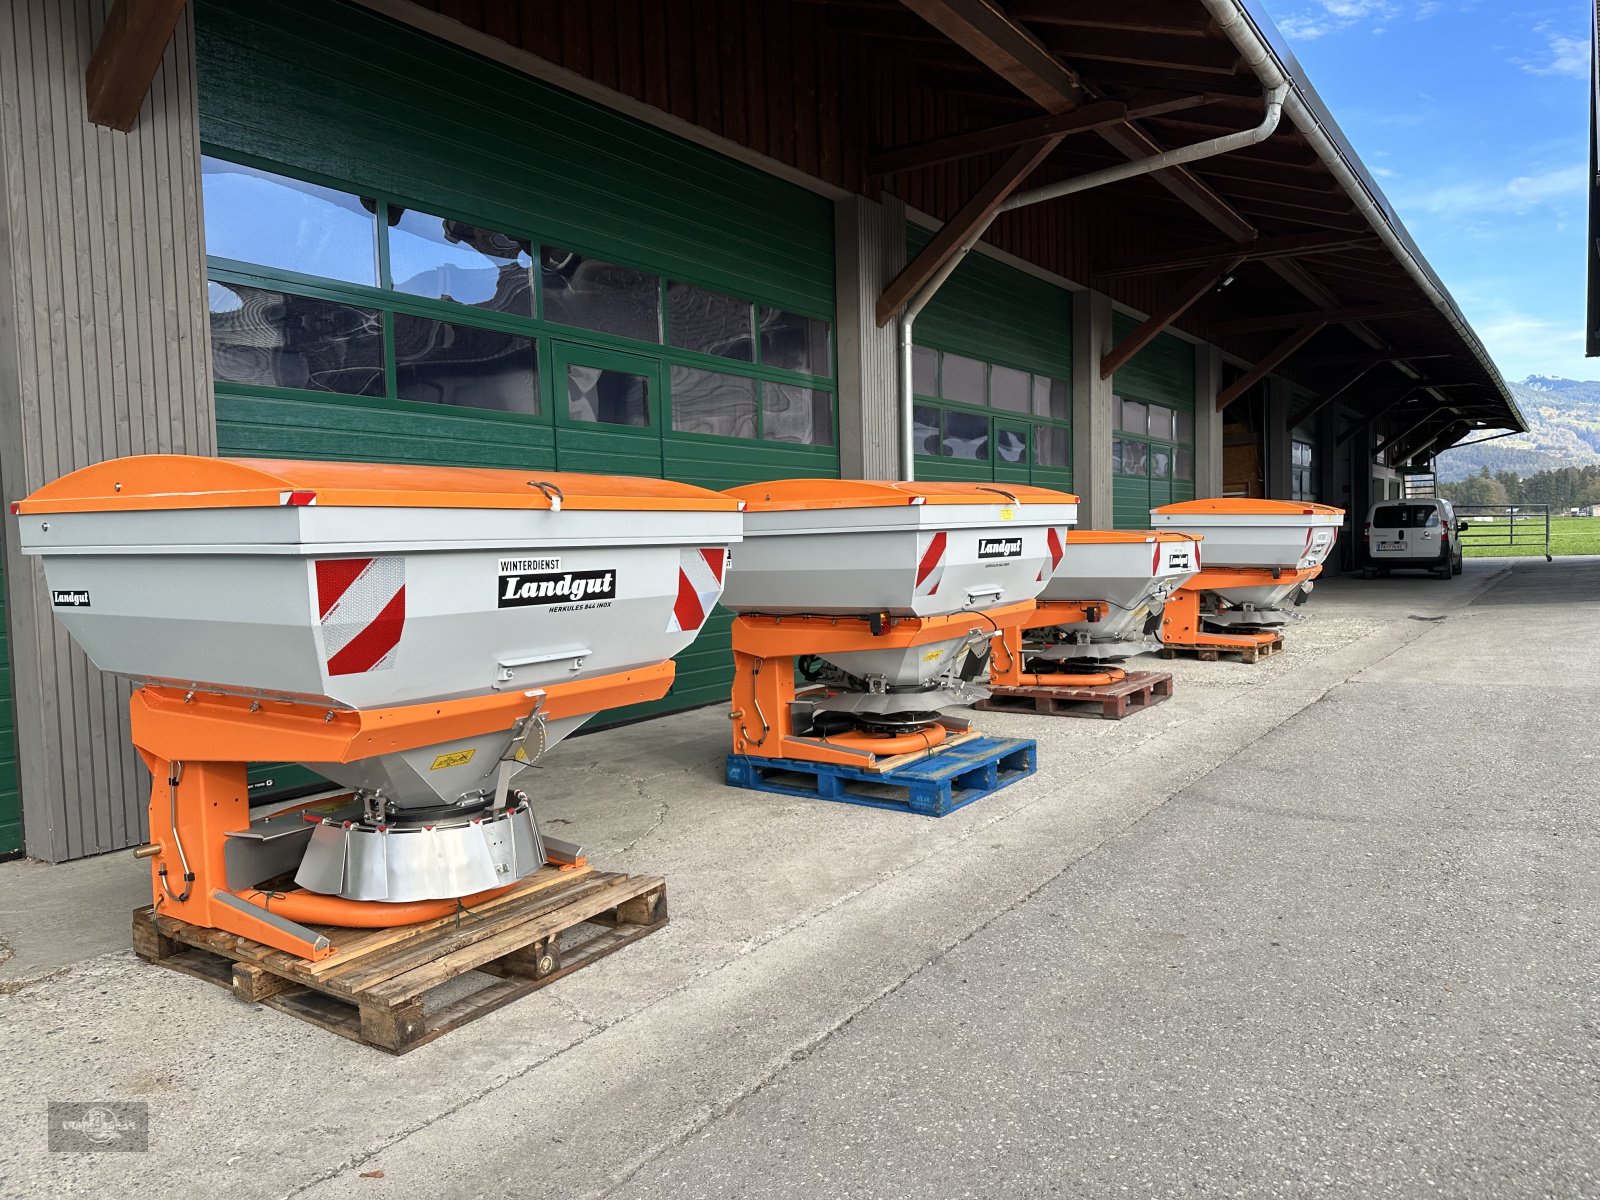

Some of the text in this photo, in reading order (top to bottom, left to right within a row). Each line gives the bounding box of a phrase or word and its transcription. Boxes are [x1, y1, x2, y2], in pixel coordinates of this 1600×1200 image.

[980, 539, 1021, 556] Landgut
[500, 559, 560, 572] WINTERDIENST
[501, 573, 613, 601] Landgut
[54, 592, 88, 605] Landgut
[548, 603, 584, 613] HERKULES
